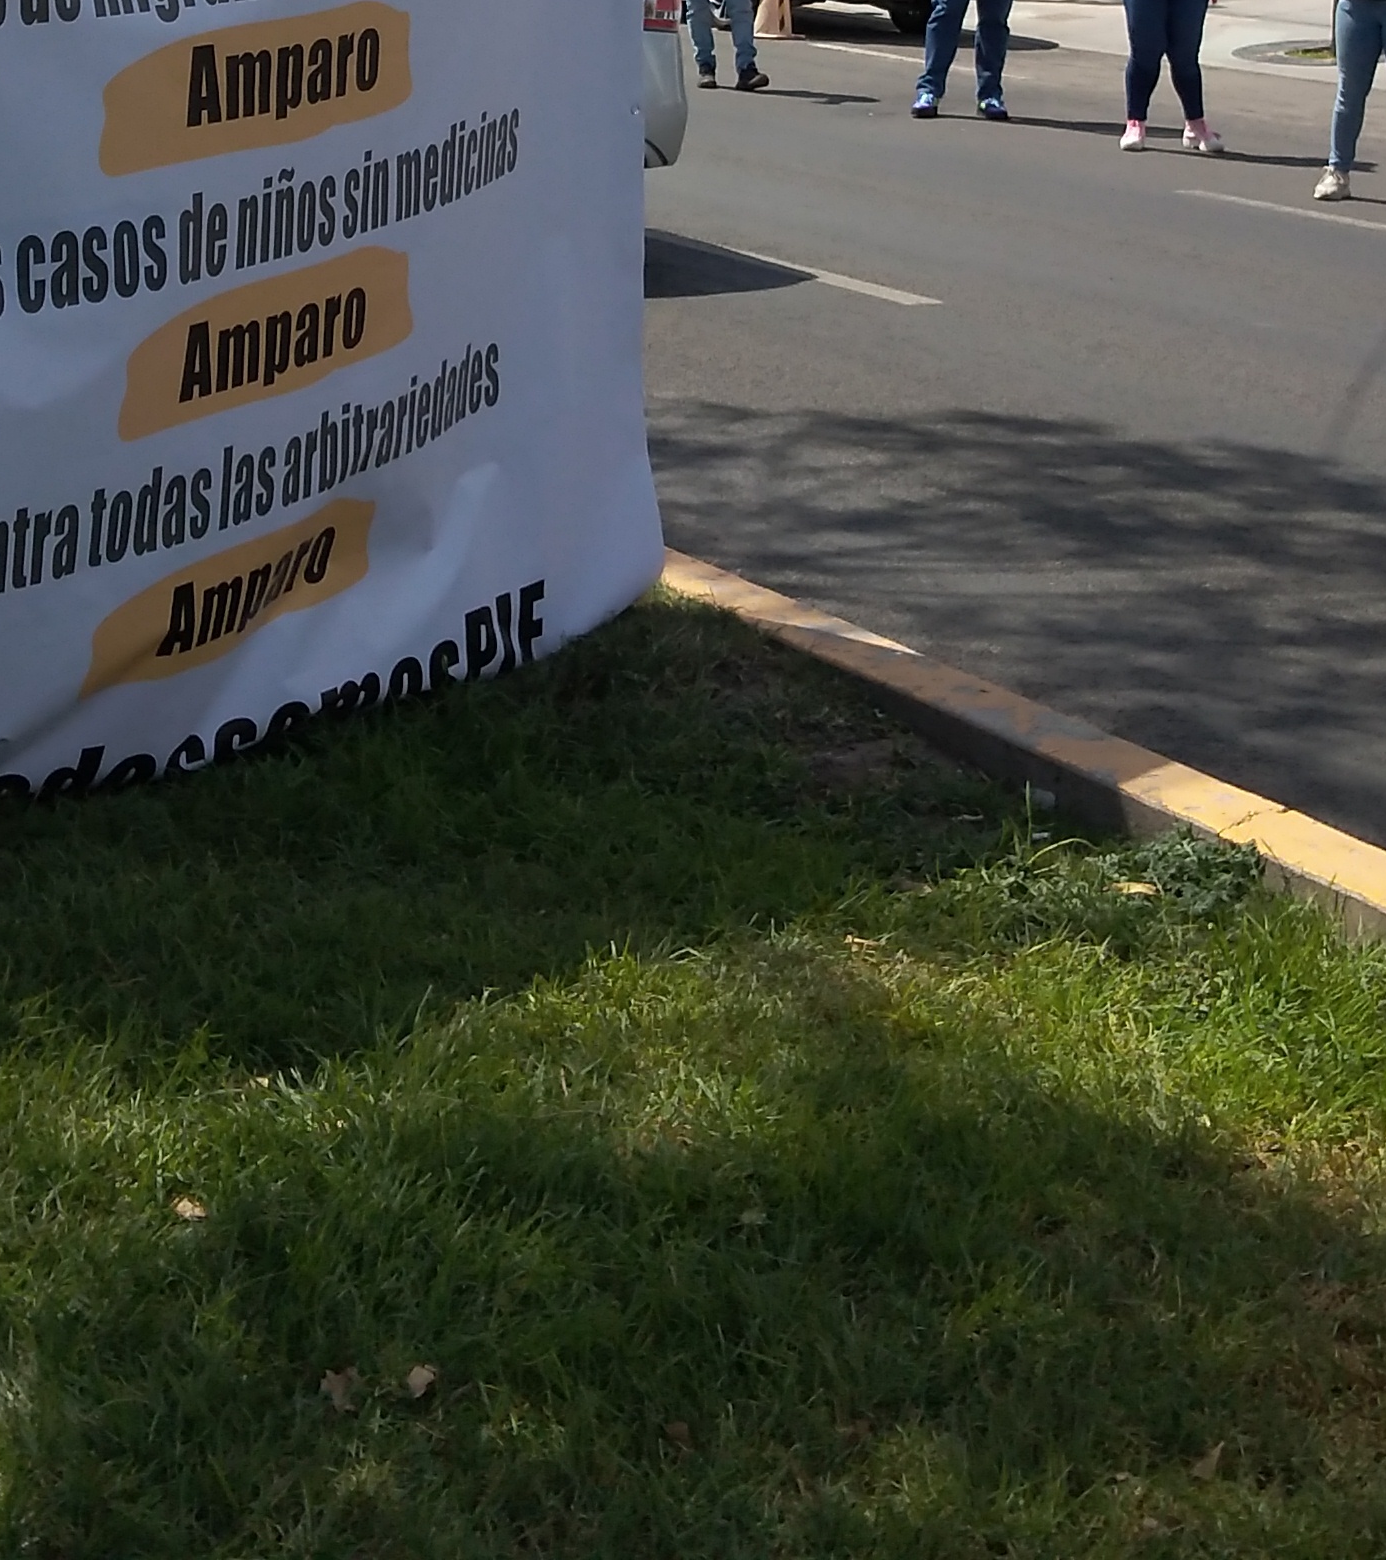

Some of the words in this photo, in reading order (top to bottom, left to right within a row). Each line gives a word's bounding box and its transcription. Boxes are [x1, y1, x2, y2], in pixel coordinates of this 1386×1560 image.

[186, 27, 381, 128] Amparo
[16, 212, 168, 315] casos
[179, 192, 226, 285] de
[235, 167, 336, 270] niños
[342, 150, 389, 241] sin
[395, 107, 520, 224] medicinas
[179, 286, 366, 404] Amparo
[88, 466, 213, 569] todas
[218, 446, 277, 532] las
[281, 343, 501, 509] arbitrariedades
[155, 526, 336, 659] Amparo
